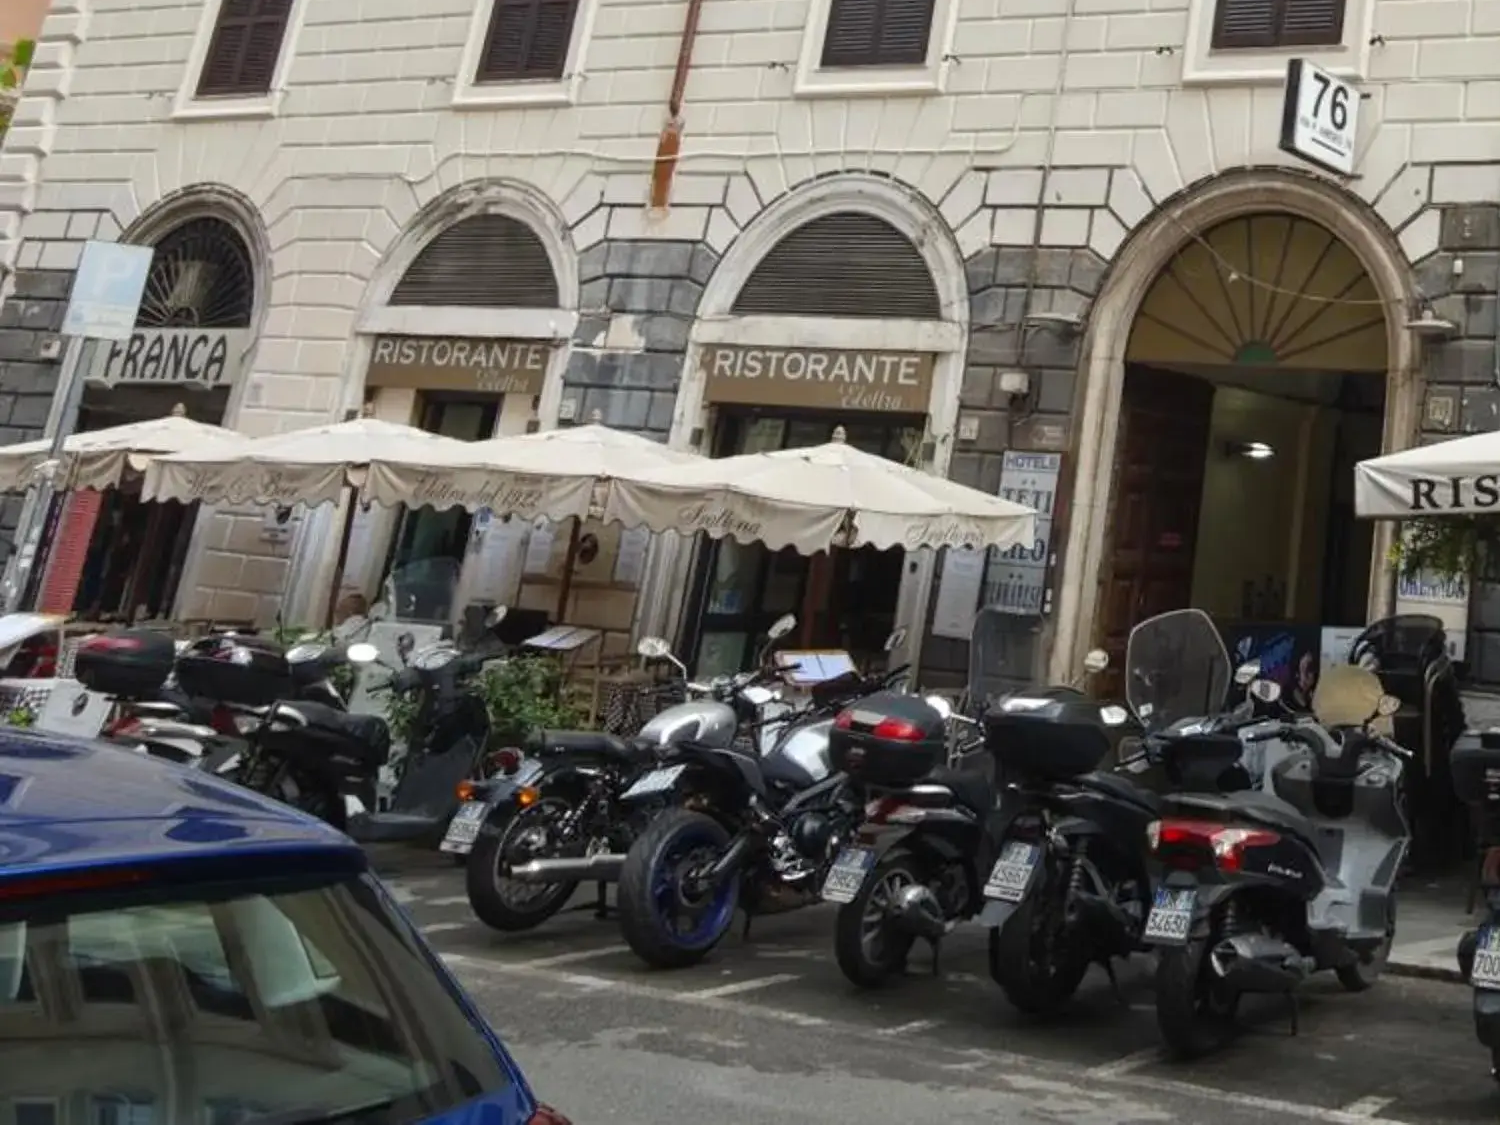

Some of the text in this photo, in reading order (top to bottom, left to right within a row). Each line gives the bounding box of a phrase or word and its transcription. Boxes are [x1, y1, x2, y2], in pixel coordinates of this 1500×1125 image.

[1312, 70, 1349, 131] 76
[104, 332, 227, 380] FRANCA
[373, 338, 545, 369] RISTORANTE
[713, 348, 921, 386] RISTORANTE
